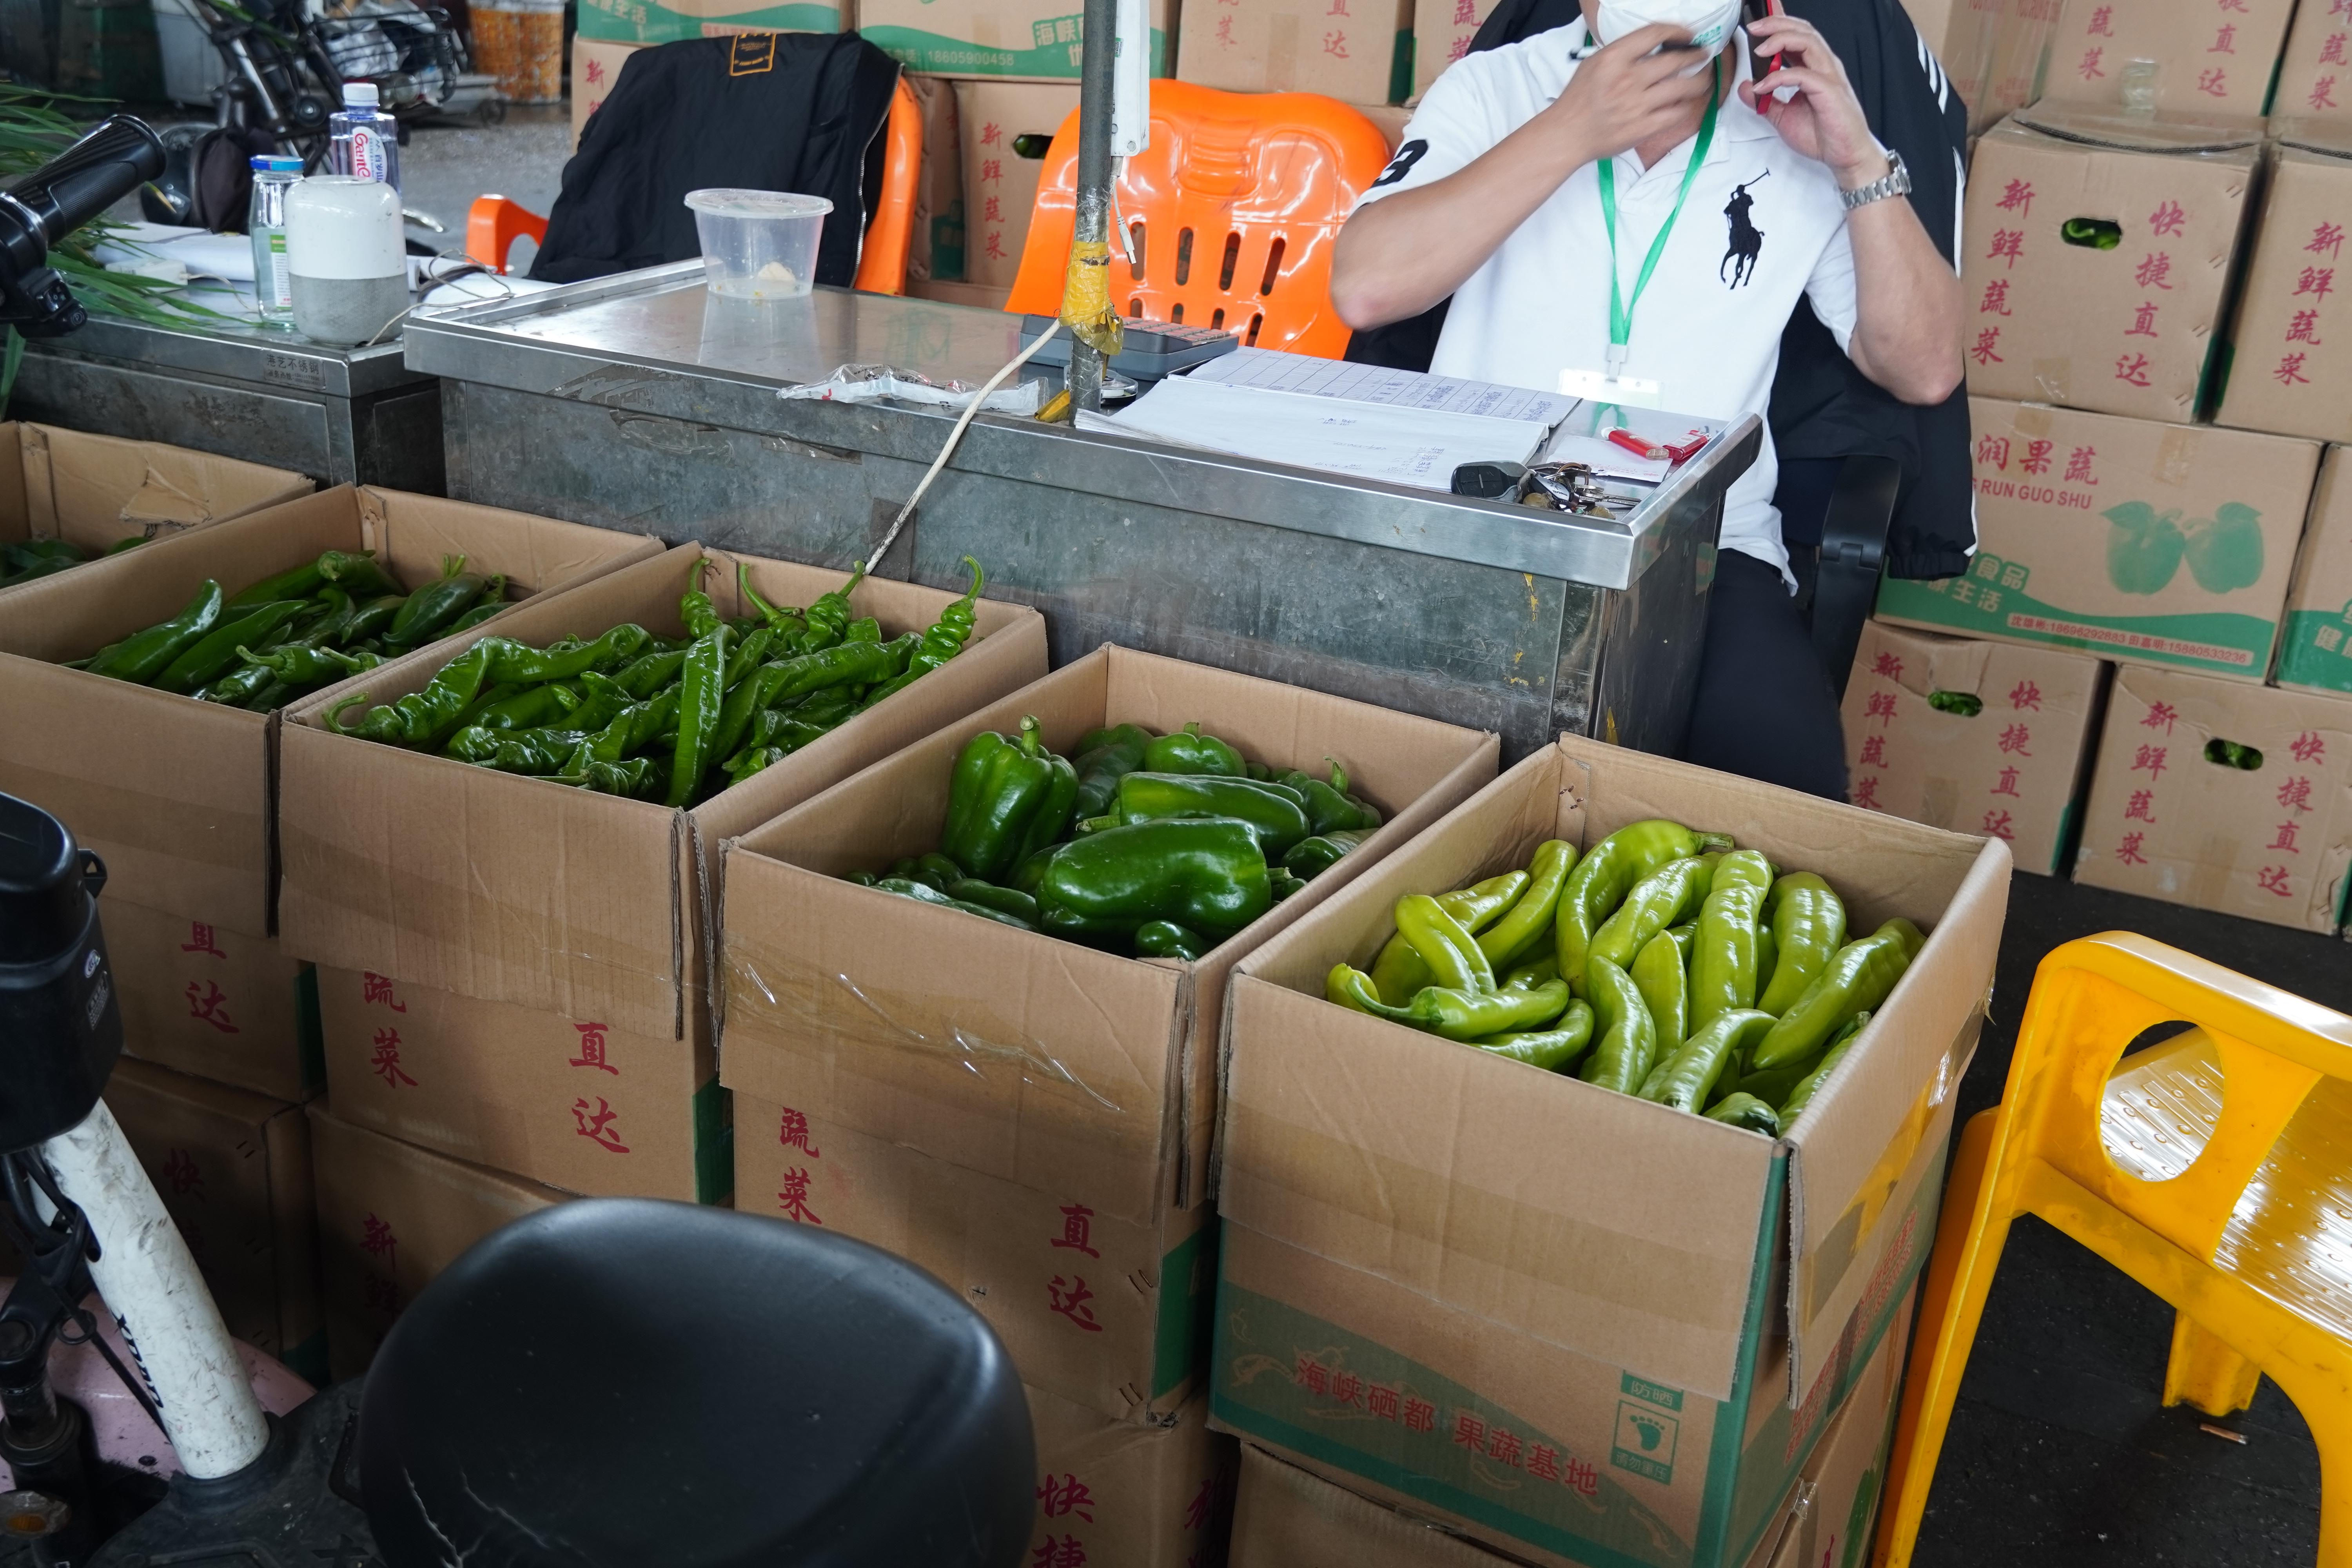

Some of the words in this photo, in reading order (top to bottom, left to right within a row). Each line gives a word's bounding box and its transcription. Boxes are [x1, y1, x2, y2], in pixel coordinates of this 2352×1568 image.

[1035, 17, 1083, 46] 海峡
[2078, 5, 2114, 80] 蔬菜
[375, 154, 383, 181] 百岁山
[981, 122, 1007, 260] 新鲜蔬菜
[1971, 178, 2036, 366] 新鲜蔬菜
[2115, 200, 2186, 387] 快捷直达
[2273, 221, 2345, 386] 新鲜蔬菜
[267, 354, 319, 374] 港艺不锈钢
[1977, 434, 2098, 485] 润果蔬
[1981, 479, 2015, 498] RUN
[2018, 485, 2054, 504] GUO
[2058, 491, 2092, 510] SHU
[1969, 554, 2027, 590] 食品
[1854, 652, 1904, 809] 新鲜蔬菜
[1983, 680, 2041, 840] 快捷直达
[2116, 701, 2178, 866] 新鲜蔬菜
[2258, 731, 2325, 897] 快捷直达
[568, 1022, 630, 1154] 直达
[778, 1107, 822, 1225] 蔬菜
[359, 1212, 402, 1348] 新鲜
[1047, 1203, 1103, 1332] 直达
[1297, 1358, 1435, 1433] 海峡硒都
[1455, 1416, 1598, 1496] 果蔬基地
[1631, 1380, 1674, 1406] 防晒
[1616, 1452, 1667, 1481] 请勿重压
